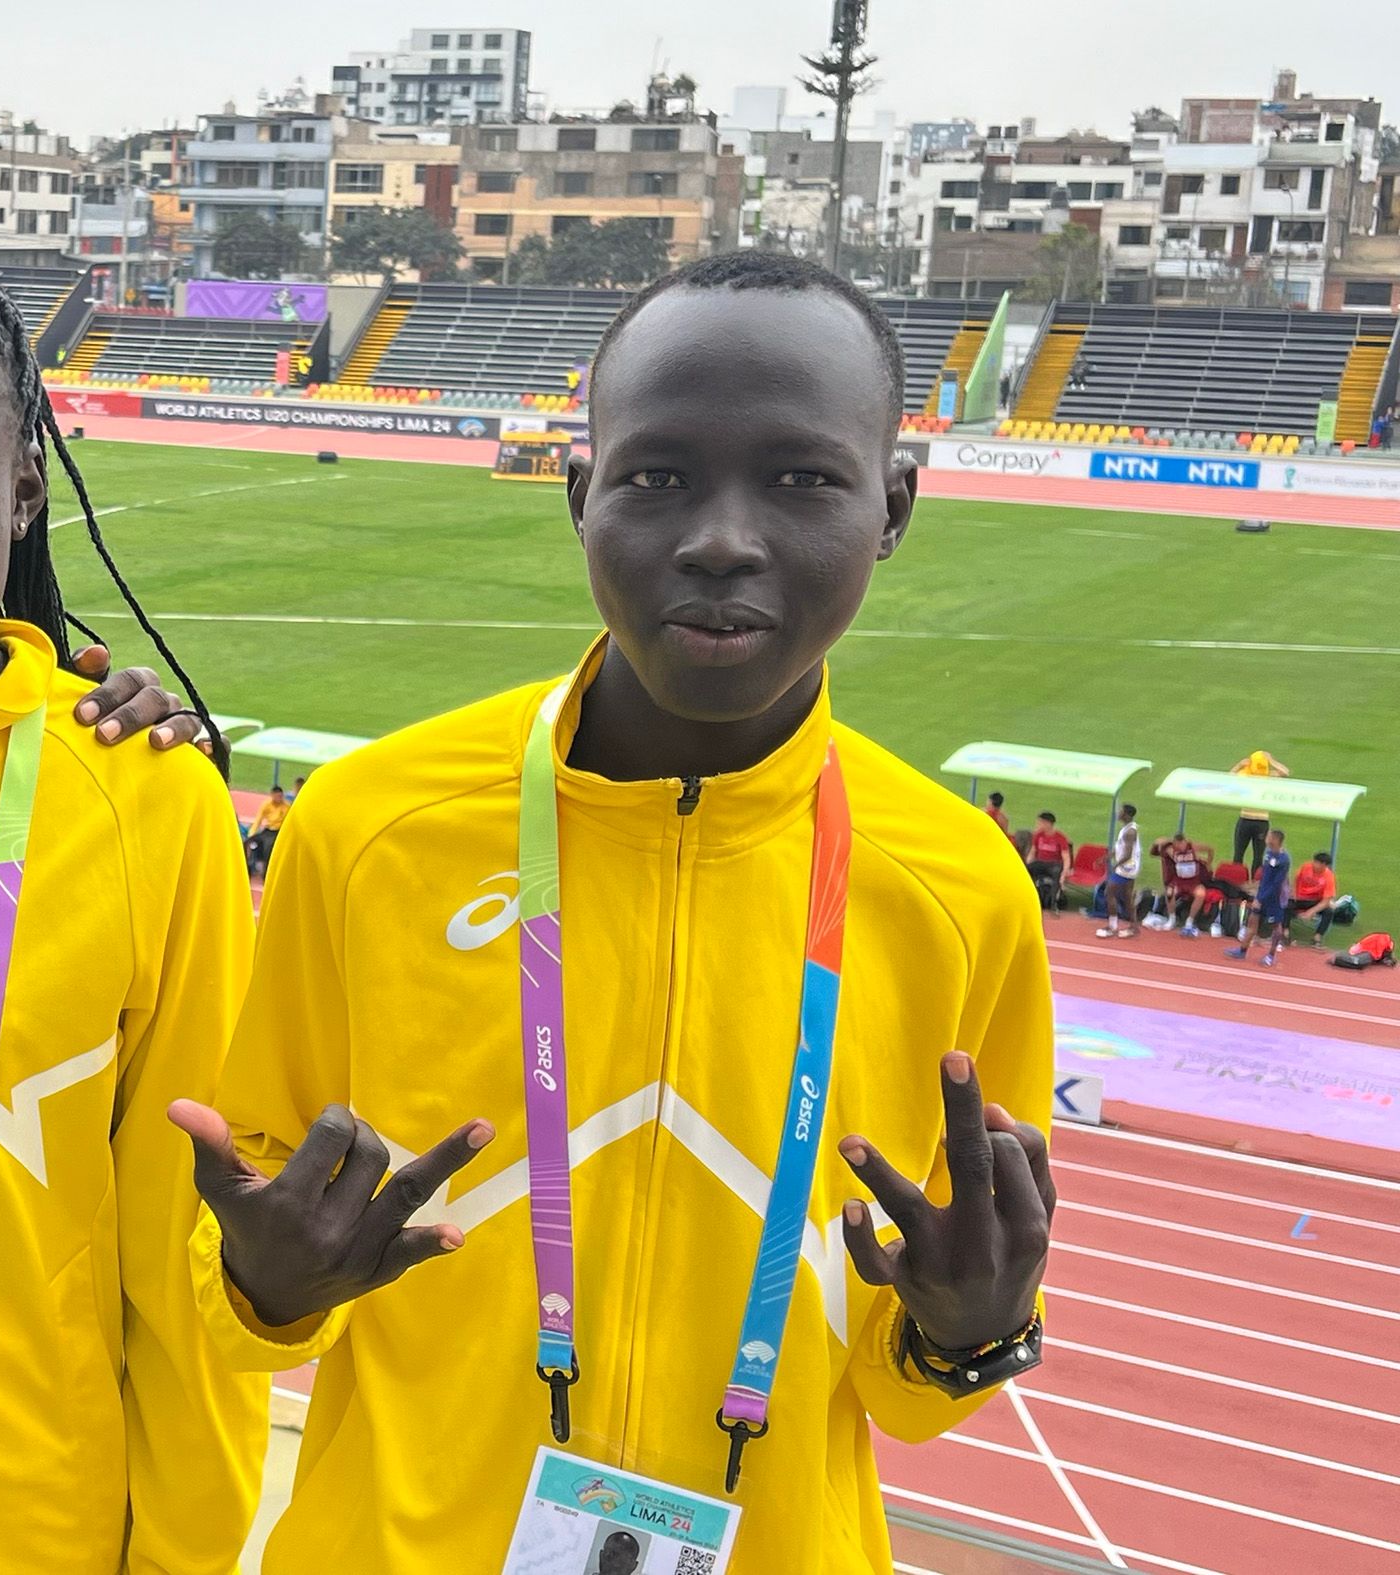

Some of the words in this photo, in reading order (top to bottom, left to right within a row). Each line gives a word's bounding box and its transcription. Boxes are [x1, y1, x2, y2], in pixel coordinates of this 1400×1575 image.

[155, 403, 195, 416] WORLD
[200, 404, 261, 421] ATHLETICS
[264, 410, 290, 422] U20
[291, 411, 394, 429] CHAMPIONSHIPS
[397, 417, 430, 431] LIMA
[432, 420, 450, 433] 24
[957, 443, 1050, 475] Corpay
[1104, 456, 1159, 480] NTN
[1188, 461, 1244, 486] NTN
[537, 1025, 551, 1069] asics
[795, 1097, 814, 1143] asics
[630, 1503, 666, 1526] LIMA
[670, 1516, 691, 1533] 24
[635, 1493, 660, 1504] WORLD
[660, 1500, 696, 1516] ATHLETICS
